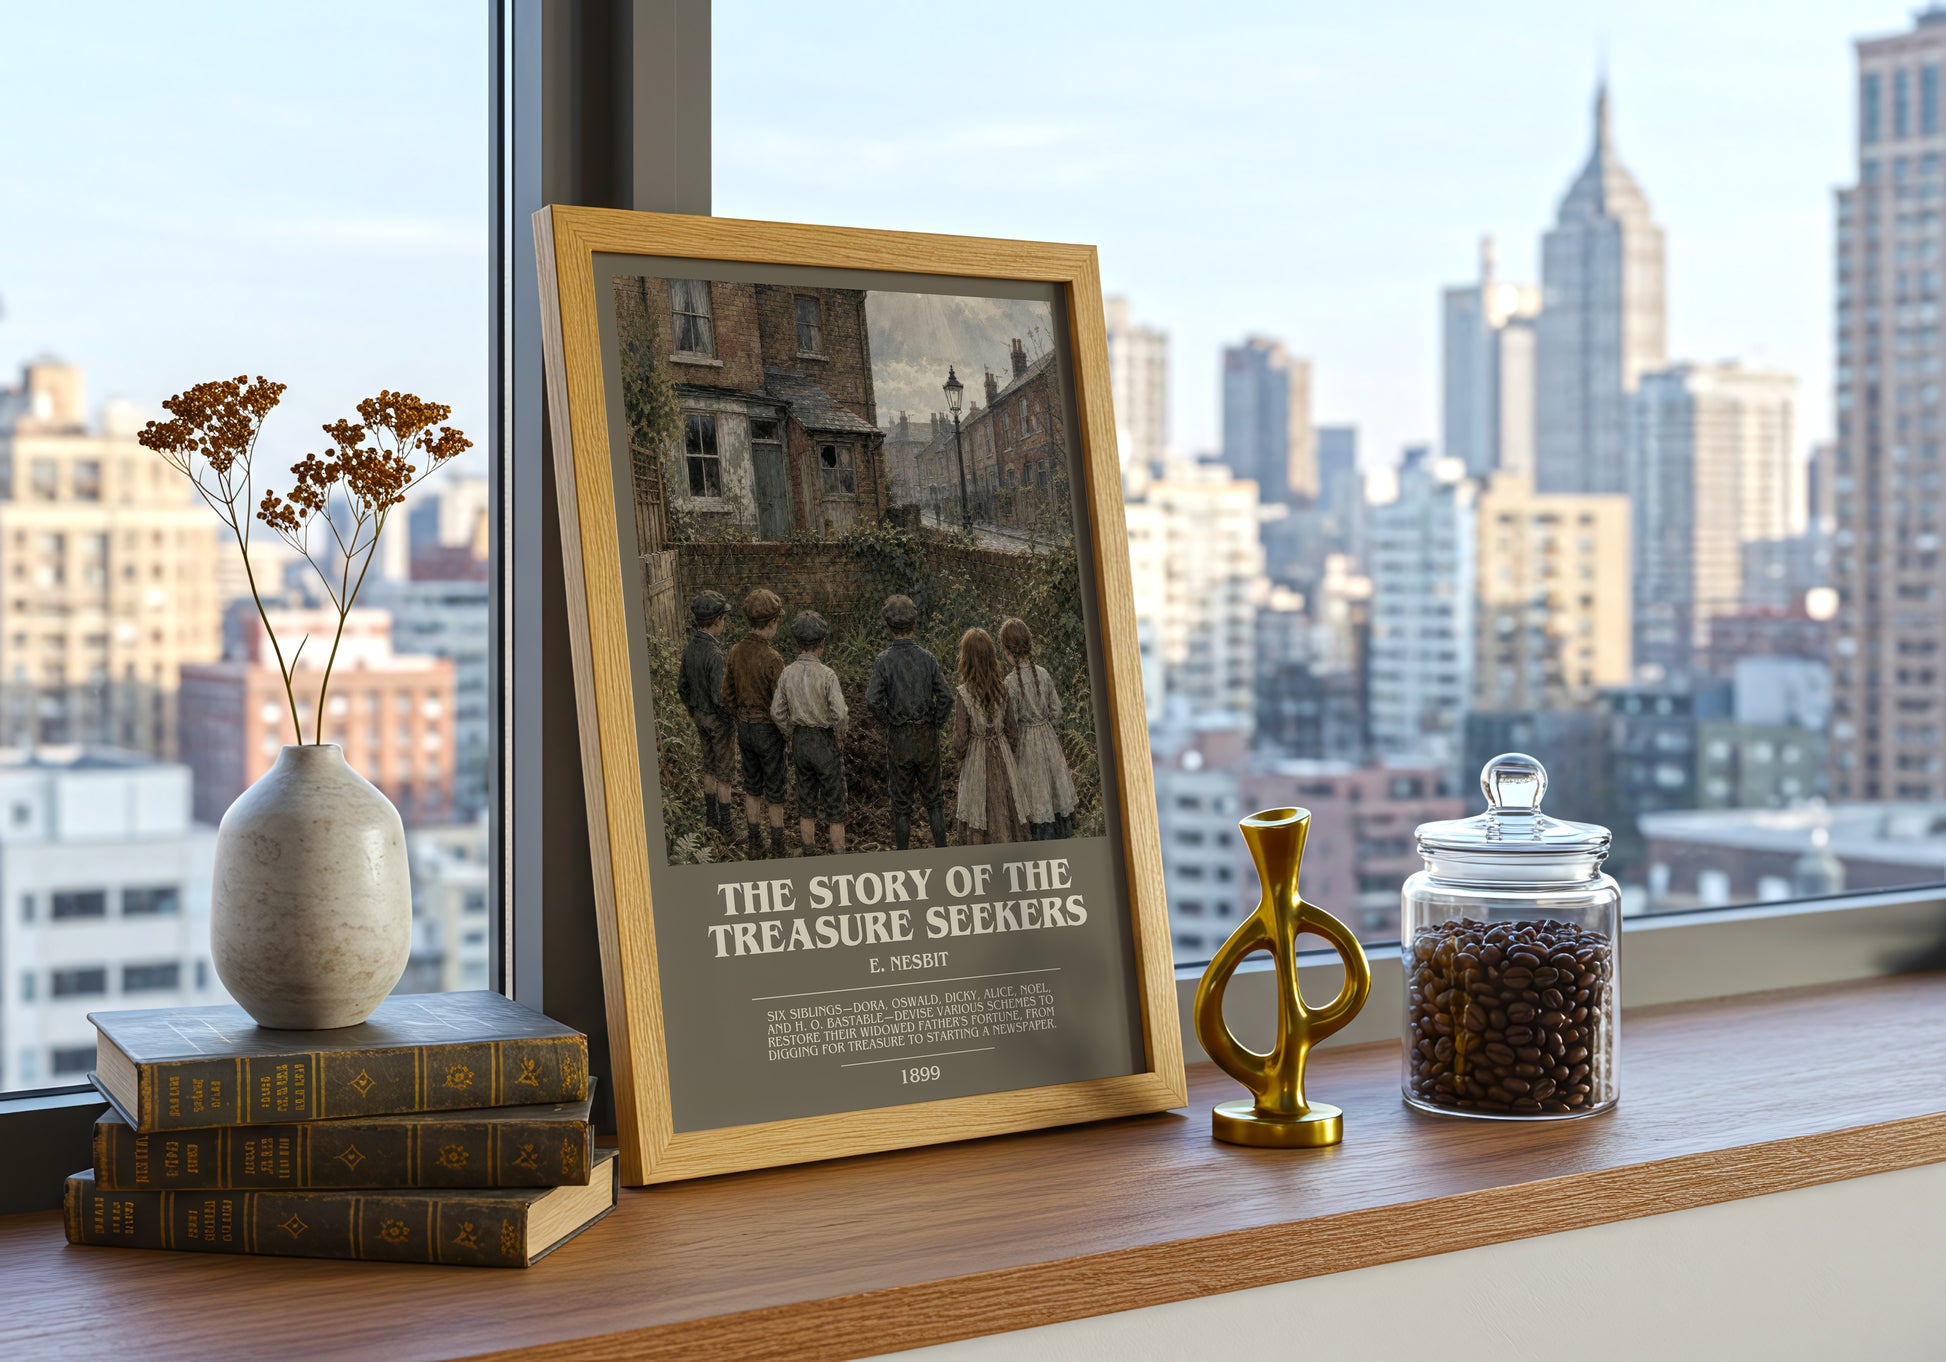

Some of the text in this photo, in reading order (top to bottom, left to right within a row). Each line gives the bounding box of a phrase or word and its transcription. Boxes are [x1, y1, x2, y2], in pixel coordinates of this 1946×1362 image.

[717, 858, 1072, 916] THE STORY OF THE
[708, 895, 1087, 958] TREASURE SEEKERS
[869, 951, 949, 973] E. NESBIT
[767, 1010, 786, 1021] SIX
[892, 994, 941, 1008] OSWALD,
[945, 990, 980, 1003] DICKY,
[984, 986, 1017, 999] ALICE,
[1020, 983, 1051, 995] NOEL,
[767, 1022, 791, 1035] AND
[795, 1021, 807, 1032] H.
[811, 1019, 823, 1030] O.
[937, 1001, 984, 1016] VARIOUS
[987, 998, 1036, 1011] SCHEMES
[1039, 994, 1053, 1005] TO
[768, 1007, 1055, 1047] RESTORE THEIR WIDOWED FATHER'S FORTUNE, FROM
[769, 1019, 1057, 1061] DIGGING FOR TREASURE TO STARTING A NEWSPAPER.
[901, 1066, 940, 1084] 1899
